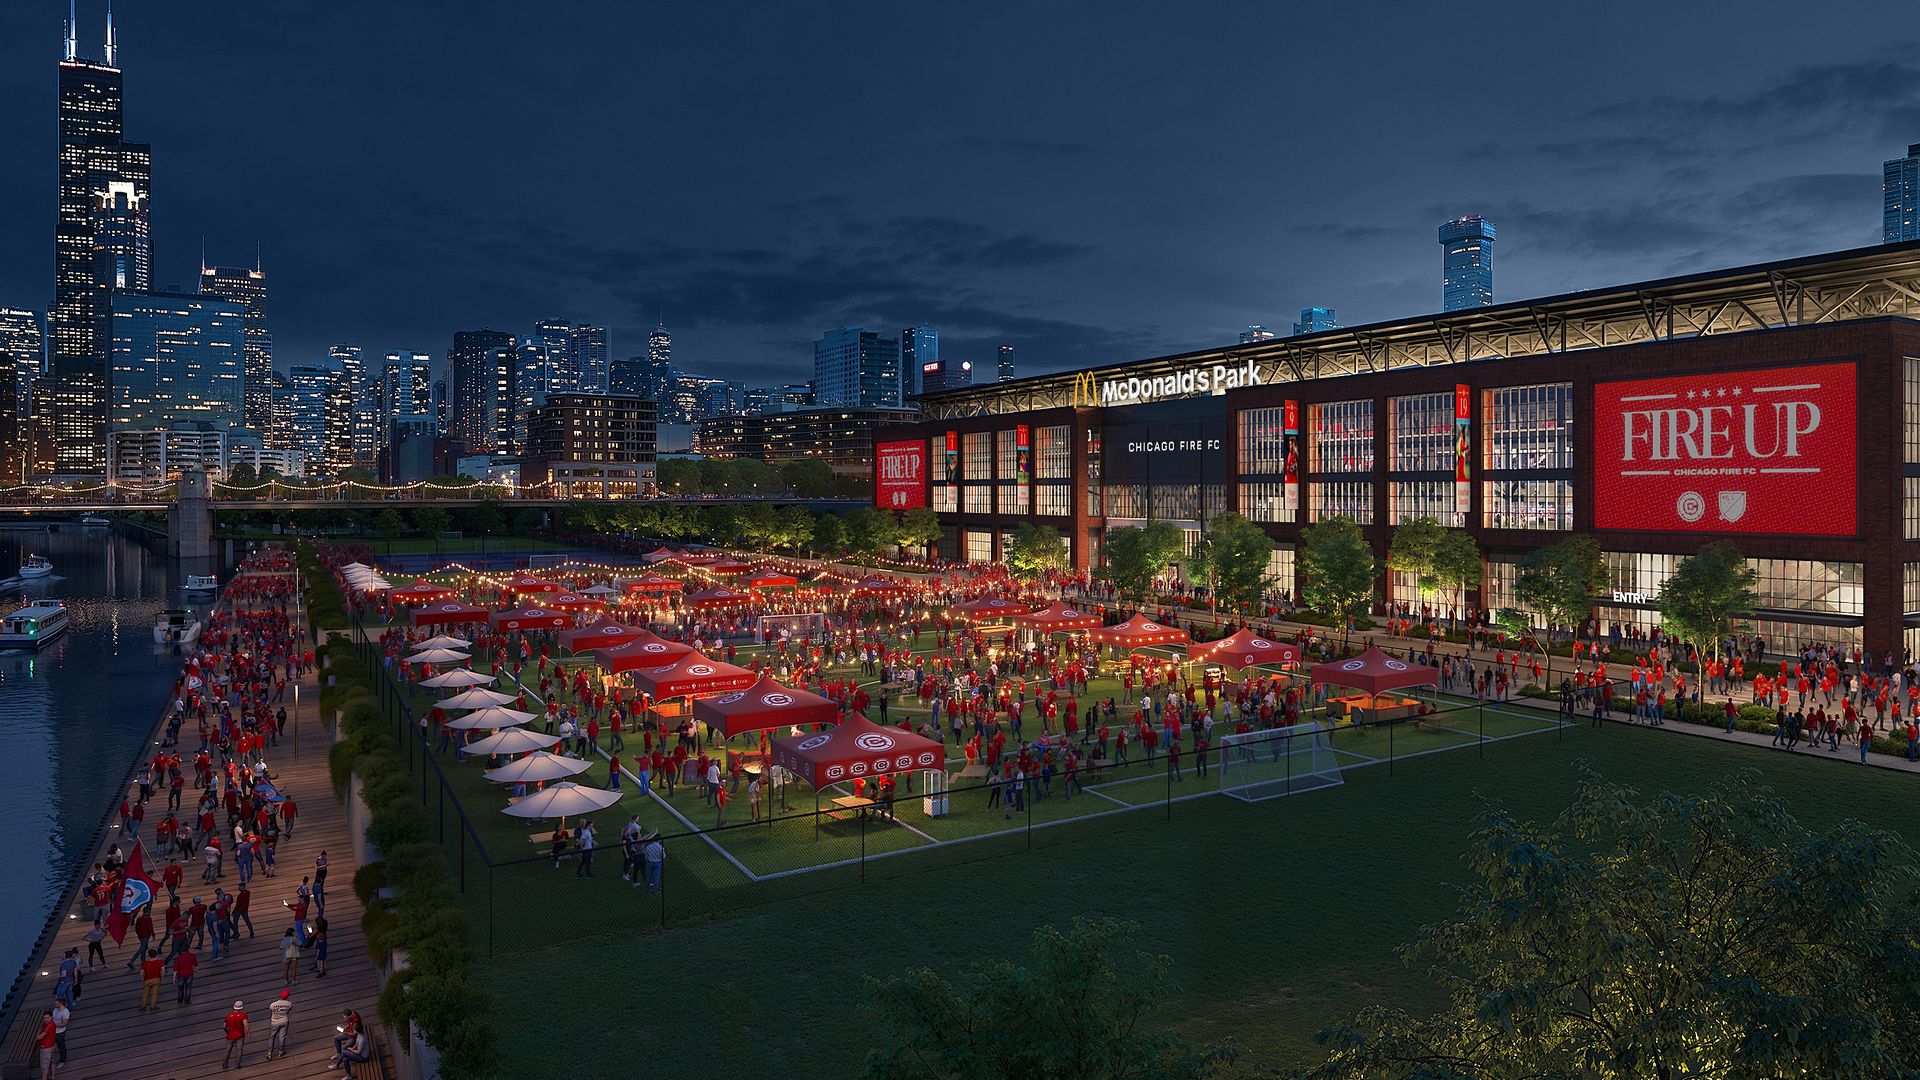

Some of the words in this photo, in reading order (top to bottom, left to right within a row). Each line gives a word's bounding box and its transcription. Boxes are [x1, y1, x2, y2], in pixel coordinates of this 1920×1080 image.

[1102, 369, 1210, 402] McDonald's
[1213, 359, 1262, 389] Park
[1460, 397, 1467, 416] 19
[1289, 412, 1294, 426] 9
[1621, 405, 1733, 461] FIRE
[1742, 401, 1821, 458] UP
[1128, 441, 1175, 452] CHICAGO
[1179, 440, 1202, 451] FIRE
[1207, 440, 1220, 450] FC
[882, 455, 904, 478] FIRE
[905, 454, 920, 478] UP
[1673, 468, 1718, 476] CHICAGO
[1613, 592, 1648, 604] ENTRY
